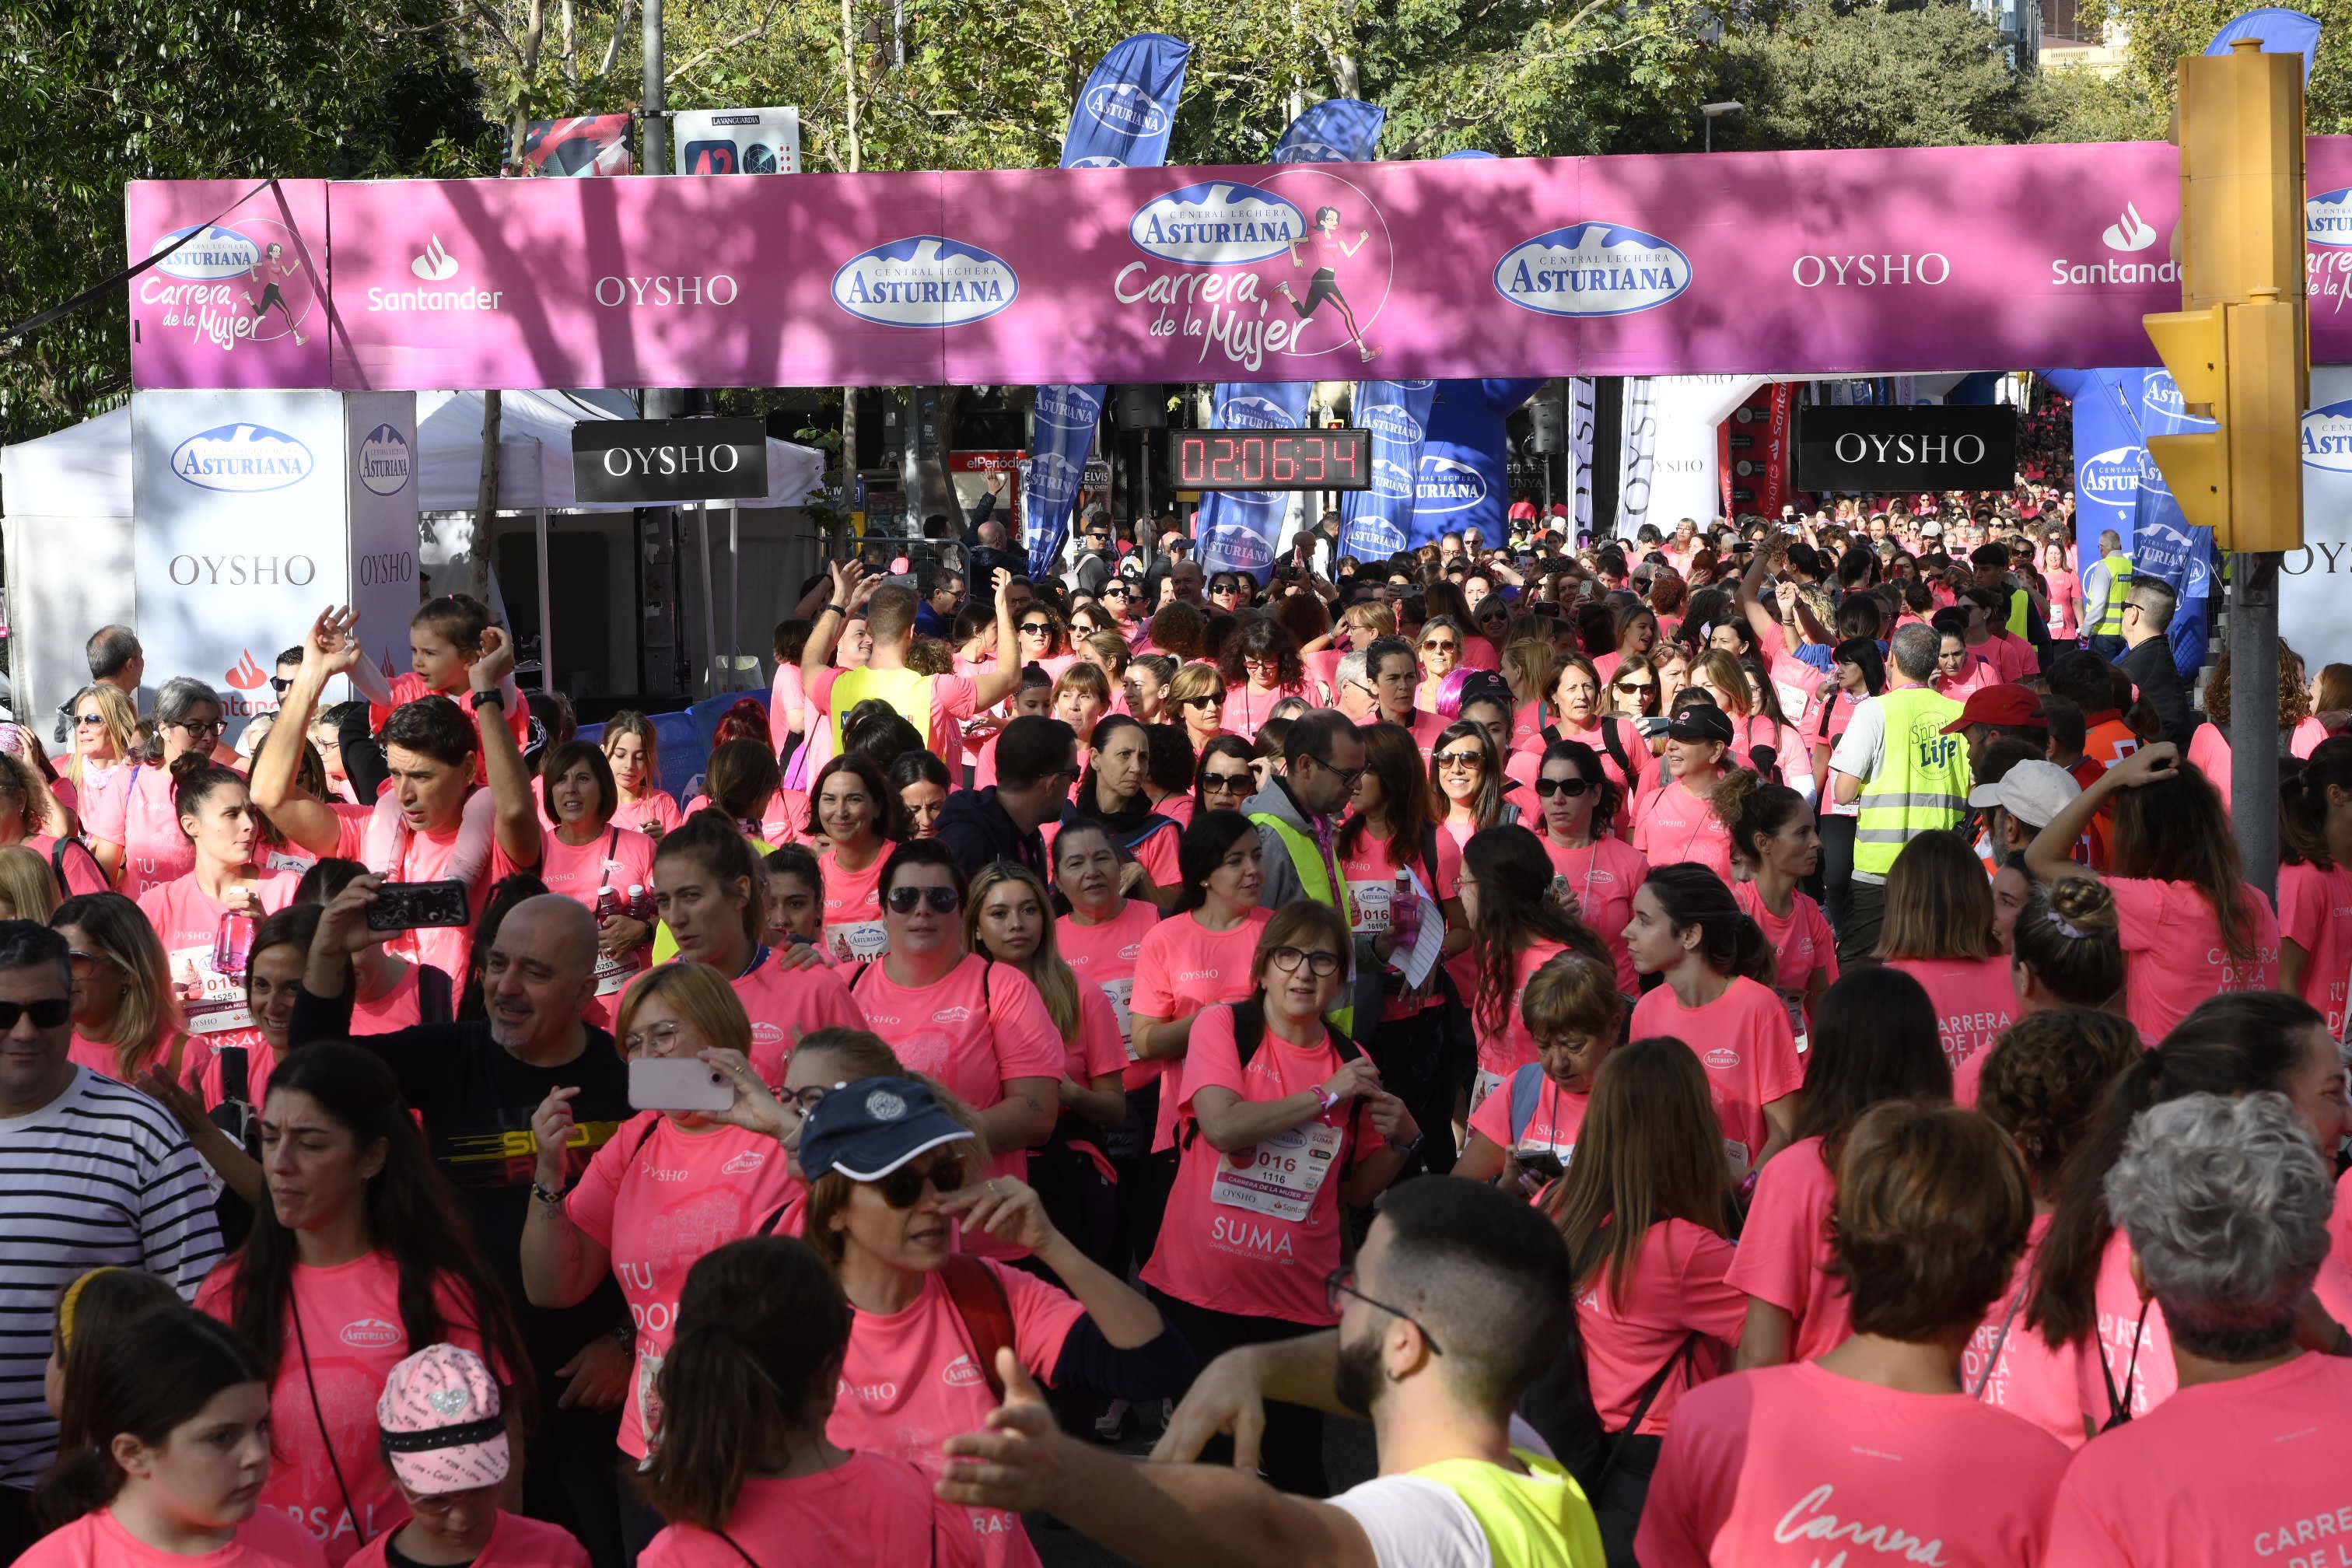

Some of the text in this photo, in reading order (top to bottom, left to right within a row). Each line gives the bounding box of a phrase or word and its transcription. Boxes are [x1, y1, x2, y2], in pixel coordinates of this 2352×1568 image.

[1170, 208, 1287, 219] CENTRAL LECHERA
[1143, 212, 1291, 245] ASTURIANA
[875, 266, 998, 278] CENTRAL LECHERA
[1539, 253, 1670, 266] CENTRAL LECHERA
[1792, 252, 1951, 287] OYSHO
[846, 269, 1003, 305] ASTURIANA
[1113, 260, 1260, 305] Carrera
[1509, 258, 1677, 294] ASTURIANA
[139, 275, 232, 307] Carrera
[367, 285, 503, 312] Santander
[595, 275, 738, 307] OYSHO
[163, 303, 265, 351] de la Mujer
[1150, 299, 1314, 372] de la Mujer
[603, 443, 739, 478] OYSHO
[1182, 438, 1356, 482] 02:06:34
[1835, 432, 1986, 465] OYSHO
[184, 452, 303, 476] ASTURIANA
[362, 455, 408, 478] ASTURIANA
[1084, 471, 1108, 481] ELVIS
[168, 554, 316, 586] OYSHO
[360, 551, 411, 586] OYSHO
[1920, 736, 1957, 768] Life
[1363, 909, 1390, 920] 016
[207, 976, 240, 992] 016
[1180, 968, 1218, 982] OYSHO
[212, 992, 238, 1003] 15251
[1943, 1032, 1967, 1054] DE
[1706, 1055, 1738, 1064] ASTURIANA
[1258, 1152, 1297, 1172] 016
[1228, 1175, 1301, 1199] CARRERA DE LA MUJER
[1262, 1171, 1286, 1185] 1116
[1222, 1187, 1256, 1204] OYSHO
[1211, 1216, 1294, 1256] SUMA
[620, 1262, 653, 1290] TU
[345, 1329, 397, 1342] ASTURIANA
[1773, 1483, 1949, 1567] Carrera
